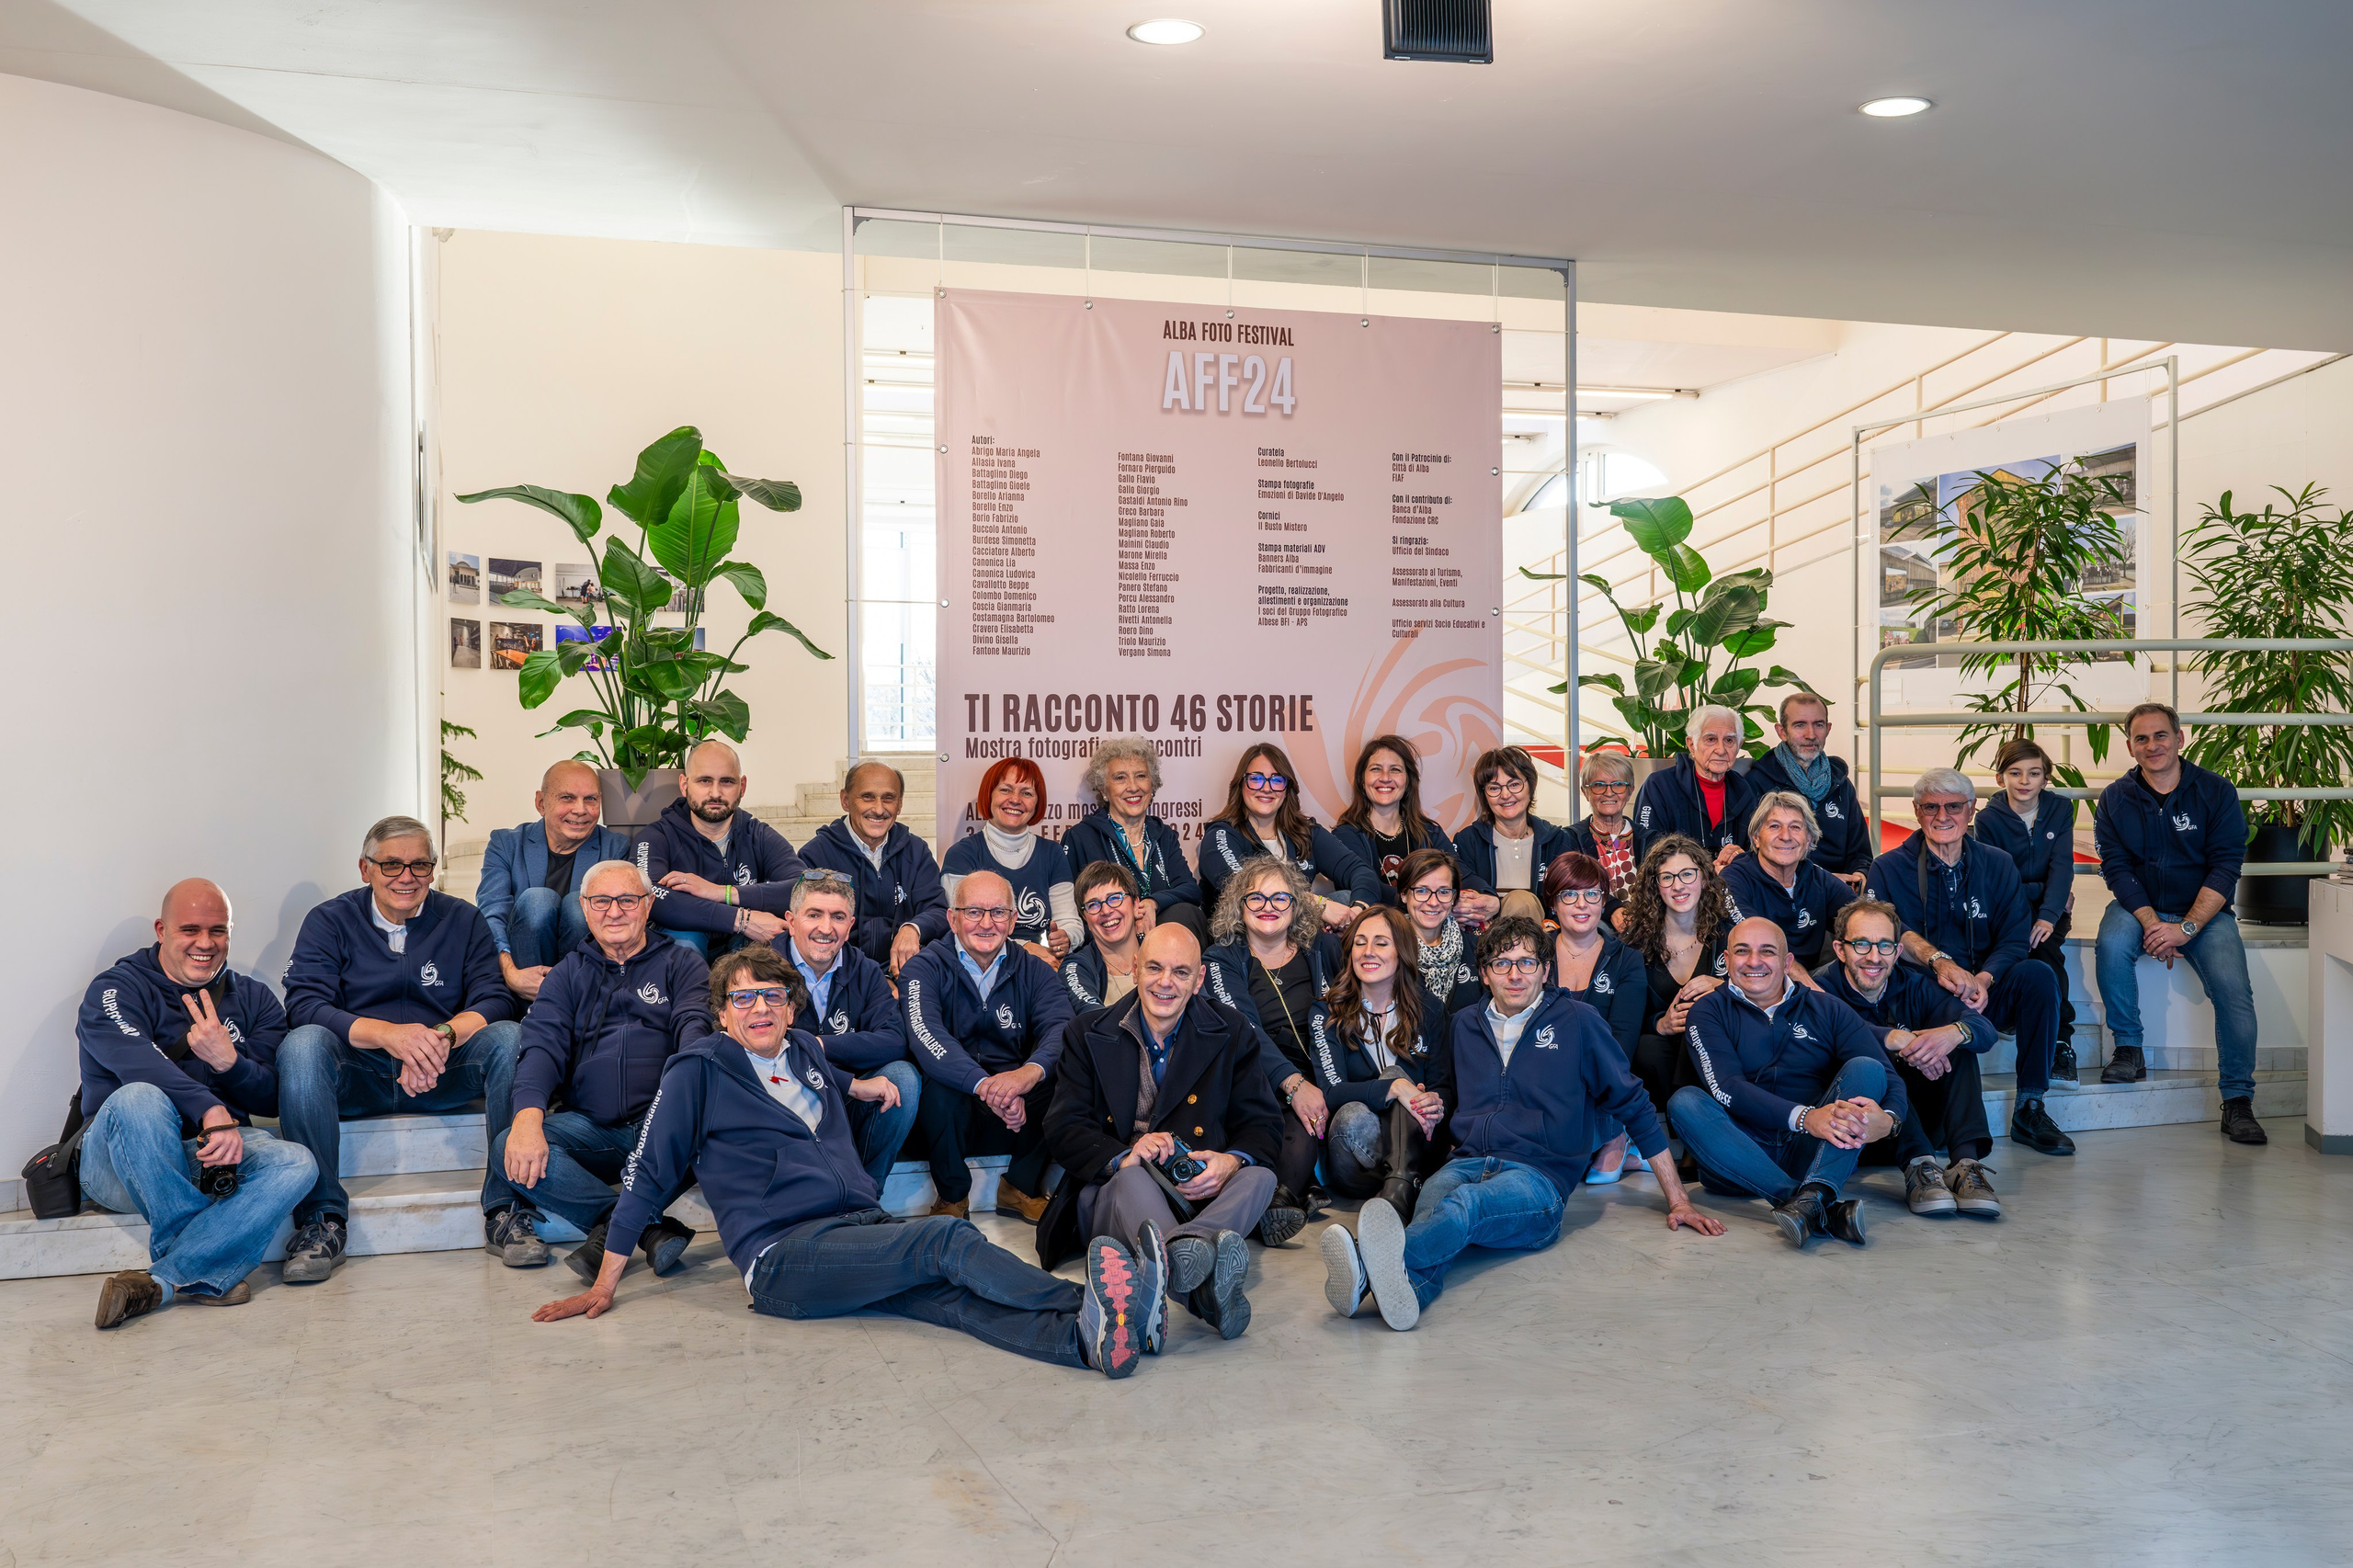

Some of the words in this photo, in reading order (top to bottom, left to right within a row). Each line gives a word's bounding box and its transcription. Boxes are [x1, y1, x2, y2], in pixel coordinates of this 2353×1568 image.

[1163, 320, 1197, 340] ALBA
[1202, 323, 1233, 343] FOTO
[1237, 324, 1294, 347] FESTIVAL
[1163, 350, 1295, 415] AFF24
[972, 436, 995, 445] Autori:
[972, 447, 994, 456] Abrigo
[995, 448, 1015, 456] Maria
[1017, 449, 1040, 458] Angela
[1119, 452, 1143, 461] Fontana
[1146, 453, 1173, 462] Giovanni
[1258, 448, 1284, 457] Curatela
[1392, 453, 1403, 461] Con
[1412, 454, 1441, 462] Patrocinio
[972, 458, 995, 467] Allasia
[997, 459, 1015, 468] Ivana
[1286, 459, 1317, 469] Bertolucci
[1392, 463, 1406, 472] Città
[1416, 464, 1429, 472] Alba
[1119, 463, 1142, 472] Fornaro
[1145, 464, 1176, 474] Pierguido
[972, 469, 1006, 479] Battaglino
[1009, 470, 1028, 480] Diego
[1119, 474, 1134, 483] Gallo
[1137, 475, 1155, 483] Flavio
[1392, 473, 1404, 482] FIAF
[972, 480, 1006, 490] Battaglino
[1009, 482, 1029, 490] Gioele
[1258, 479, 1281, 489] Stampa
[1284, 480, 1314, 490] fotografie
[1119, 485, 1134, 494] Gallo
[1137, 485, 1159, 495] Giorgio
[972, 491, 995, 500] Borello
[998, 492, 1024, 501] Arianna
[1119, 496, 1144, 505] Gastaldi
[1147, 497, 1171, 506] Antonio
[1174, 497, 1188, 506] Rino
[1392, 494, 1403, 503] Con
[1412, 495, 1442, 504] contributo
[972, 502, 995, 511] Borello
[998, 503, 1013, 511] Enzo
[1119, 506, 1136, 516] Greco
[1139, 507, 1164, 517] Barbara
[972, 513, 990, 522] Borio
[993, 514, 1018, 523] Fabrizio
[1258, 511, 1280, 520] Cornici
[1119, 517, 1148, 528] Magliano
[1151, 518, 1164, 528] Gaia
[1265, 522, 1281, 530] Busto
[1284, 523, 1307, 531] Mistero
[972, 524, 999, 533] Buccolo
[1002, 525, 1027, 534] Antonio
[1119, 528, 1148, 539] Magliano
[1151, 529, 1175, 538] Roberto
[972, 535, 999, 544] Burdese
[1002, 536, 1036, 546] Simonetta
[1119, 540, 1142, 548] Mainini
[1145, 540, 1169, 549] Claudio
[1400, 536, 1428, 546] ringrazia:
[972, 547, 1009, 555] Cacciatore
[1011, 548, 1035, 556] Alberto
[1258, 543, 1281, 552] Stampa
[1284, 544, 1312, 552] materiali
[1314, 545, 1325, 553] ADV
[1392, 547, 1412, 555] Ufficio
[1426, 547, 1449, 556] Sindaco
[1119, 551, 1142, 559] Marone
[1145, 551, 1167, 560] Mirella
[1258, 554, 1283, 562] Banners
[1286, 554, 1299, 562] Alba
[972, 557, 1004, 566] Canonica
[1006, 558, 1016, 567] Lia
[1119, 562, 1139, 570] Massa
[1142, 562, 1155, 570] Enzo
[972, 569, 1004, 577] Canonica
[1006, 570, 1035, 578] Ludovica
[1258, 564, 1293, 574] Fabbricanti
[1392, 567, 1427, 576] Assessorato
[1438, 568, 1462, 578] Turismo,
[1119, 572, 1146, 581] Nicolello
[1149, 573, 1178, 581] Ferruccio
[972, 580, 1006, 588] Cavallotto
[1009, 581, 1029, 590] Beppe
[1119, 583, 1141, 591] Panero
[1143, 584, 1167, 592] Stefano
[1392, 578, 1438, 587] Manifestazioni,
[1440, 578, 1457, 586] Eventi
[972, 590, 1002, 599] Colombo
[1004, 592, 1037, 600] Domenico
[1258, 585, 1286, 596] Progetto,
[1289, 586, 1329, 596] realizzazione,
[1119, 594, 1136, 602] Porcu
[1139, 594, 1174, 603] Alessandro
[1258, 597, 1295, 605] allestimenti
[1303, 597, 1348, 607] organizzazione
[1392, 598, 1427, 608] Assessorato
[972, 602, 995, 610] Coscia
[997, 603, 1031, 611] Gianmaria
[1119, 605, 1135, 613] Ratto
[1138, 605, 1159, 613] Lorena
[1290, 608, 1311, 617] Gruppo
[1313, 608, 1347, 617] Fotografico
[972, 613, 1014, 623] Costamagna
[1017, 614, 1054, 623] Bartolomeo
[1119, 616, 1139, 624] Rivetti
[1142, 616, 1172, 624] Antonella
[1258, 618, 1279, 626] Albese
[1280, 618, 1290, 626] BFI
[1297, 618, 1307, 626] APS
[972, 624, 998, 633] Cravero
[1001, 625, 1033, 633] Elisabetta
[1392, 619, 1412, 628] Ufficio
[1435, 619, 1450, 628] Socio
[1453, 619, 1479, 629] Educativi
[1119, 626, 1137, 634] Roero
[1392, 630, 1418, 638] Culturali
[973, 635, 993, 643] Divino
[995, 636, 1018, 644] Gisella
[1119, 637, 1136, 645] Triolo
[1139, 637, 1165, 645] Maurizio
[973, 646, 999, 654] Fantone
[1002, 646, 1030, 655] Maurizio
[1119, 648, 1144, 657] Vergano
[1147, 648, 1170, 656] Simona
[965, 694, 989, 733] TI
[1004, 694, 1159, 732] RACCONTO
[1171, 694, 1207, 732] 46
[1217, 694, 1313, 732] STORIE
[965, 737, 1021, 758] Mostra
